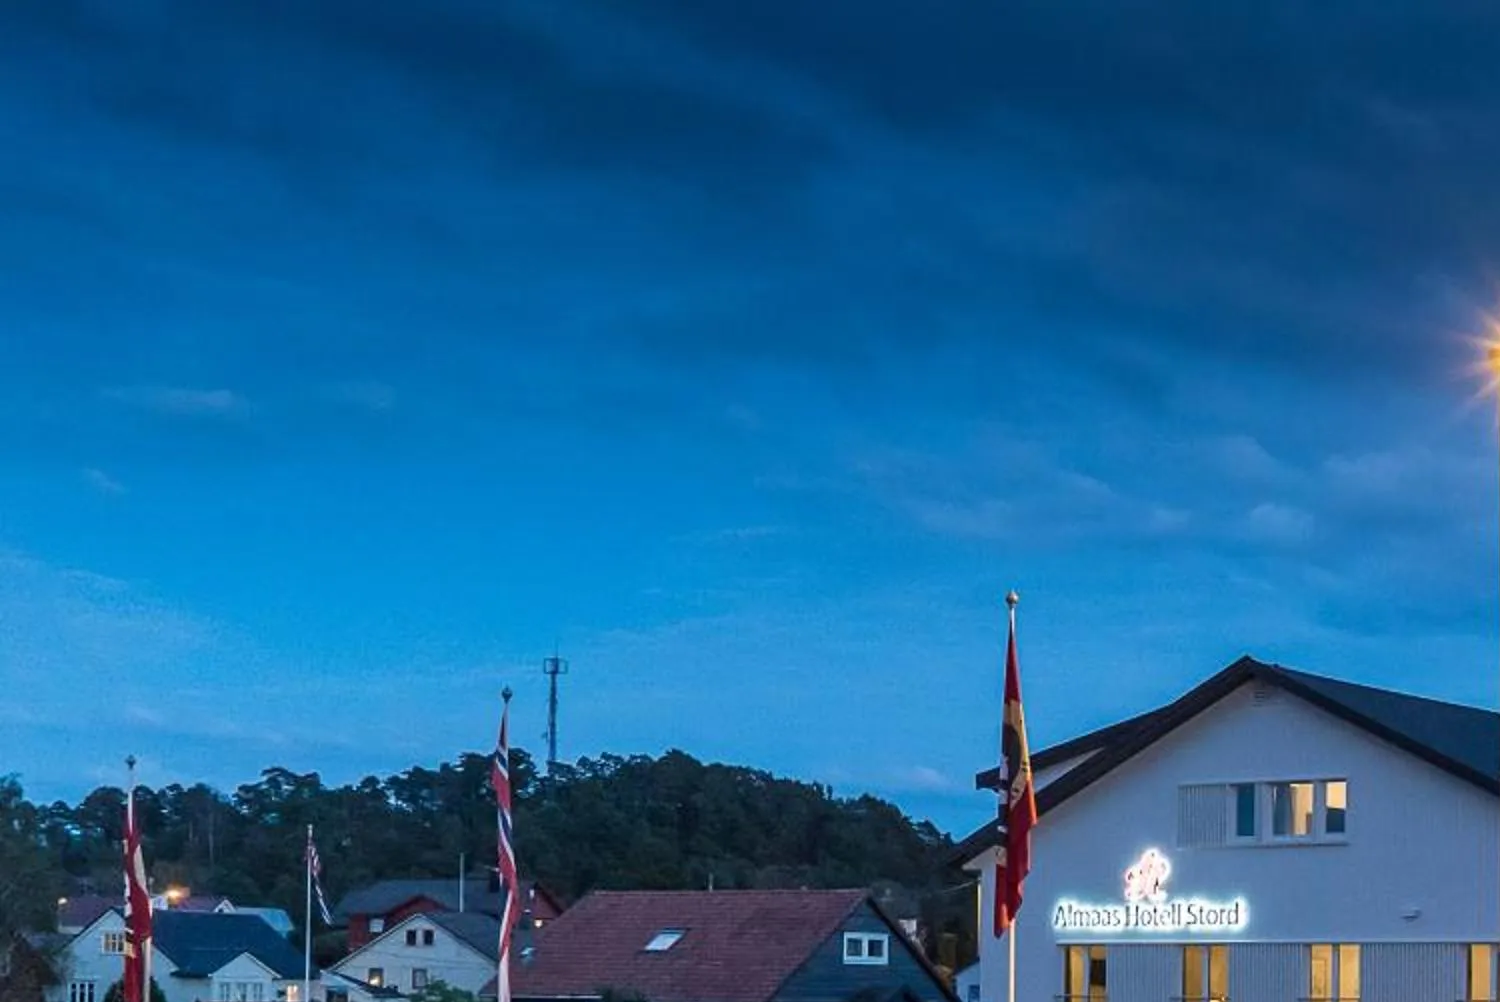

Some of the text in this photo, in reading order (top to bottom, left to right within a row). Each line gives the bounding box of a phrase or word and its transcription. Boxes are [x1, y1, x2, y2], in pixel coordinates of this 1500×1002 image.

[1054, 901, 1240, 928] Almaas Hotell Stord
